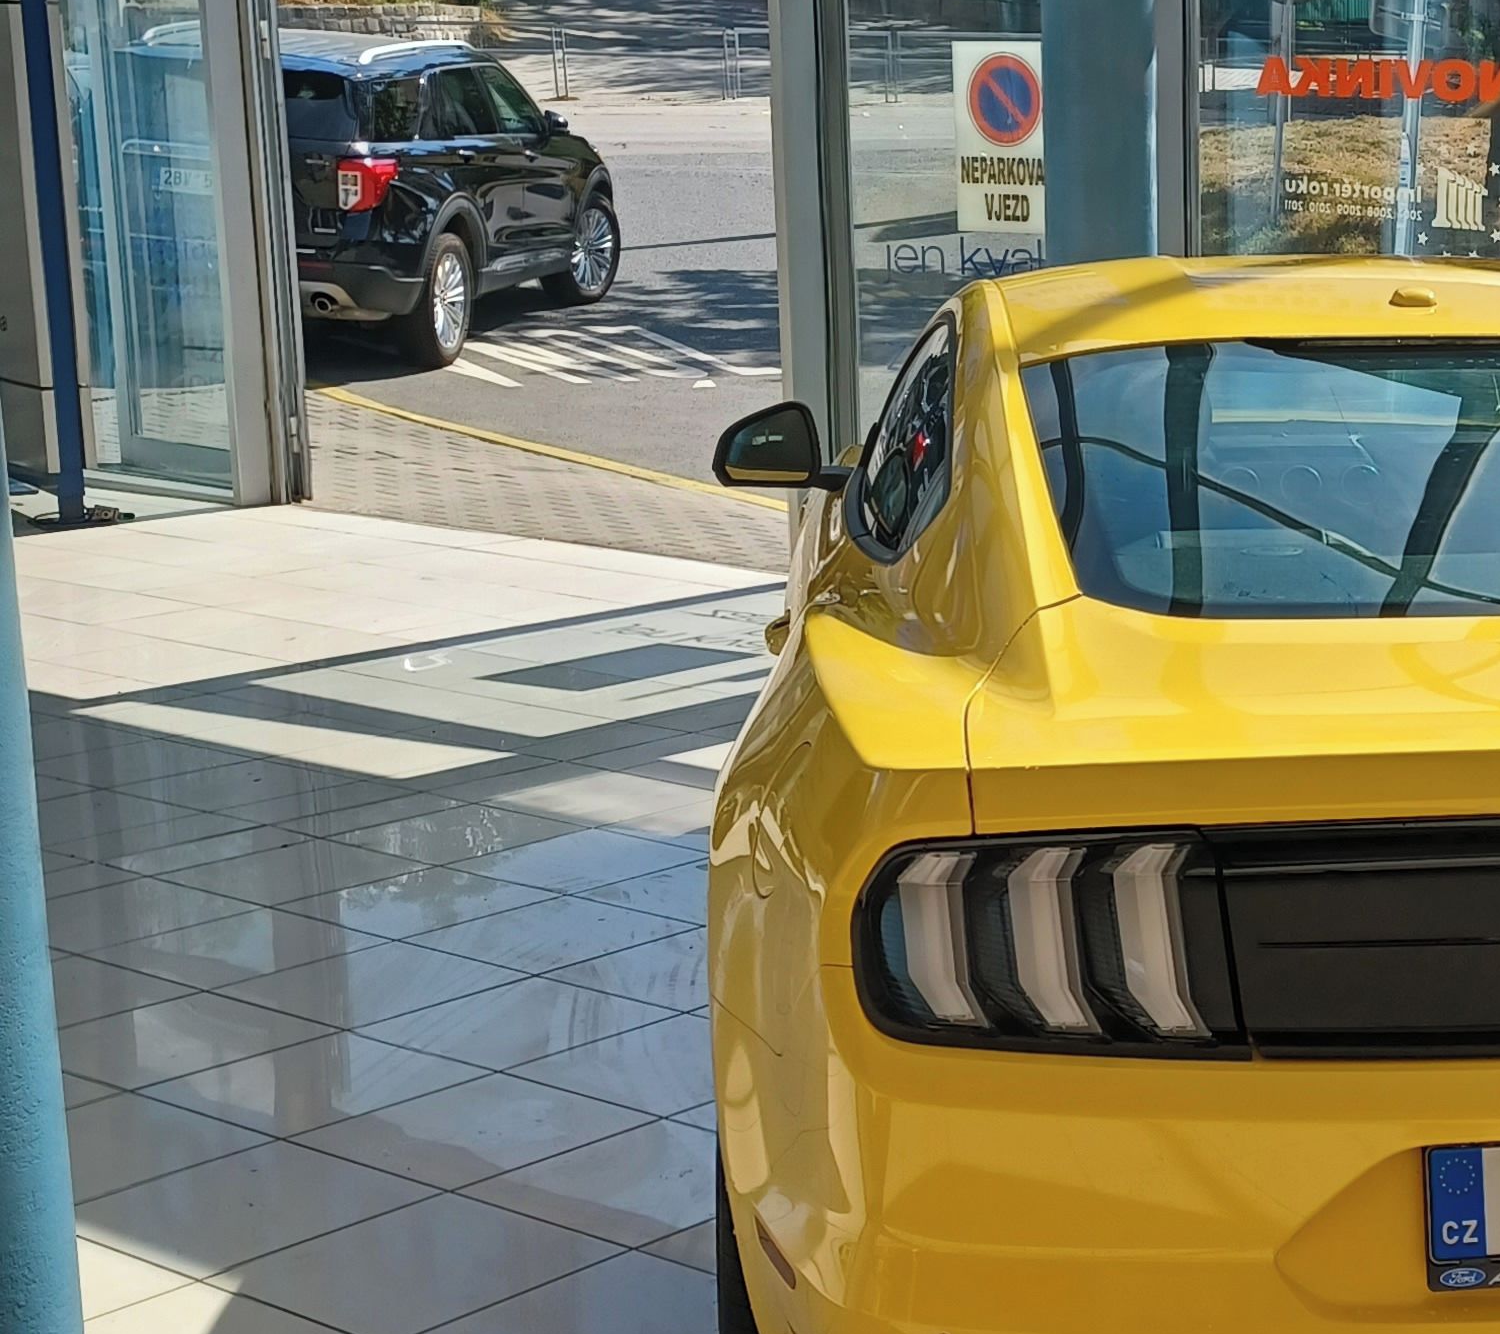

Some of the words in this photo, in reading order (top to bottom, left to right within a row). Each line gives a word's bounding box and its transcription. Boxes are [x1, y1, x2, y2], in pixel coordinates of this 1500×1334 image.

[985, 193, 1030, 222] VJEZD
[886, 244, 945, 284] jen
[1441, 1219, 1479, 1245] CZ
